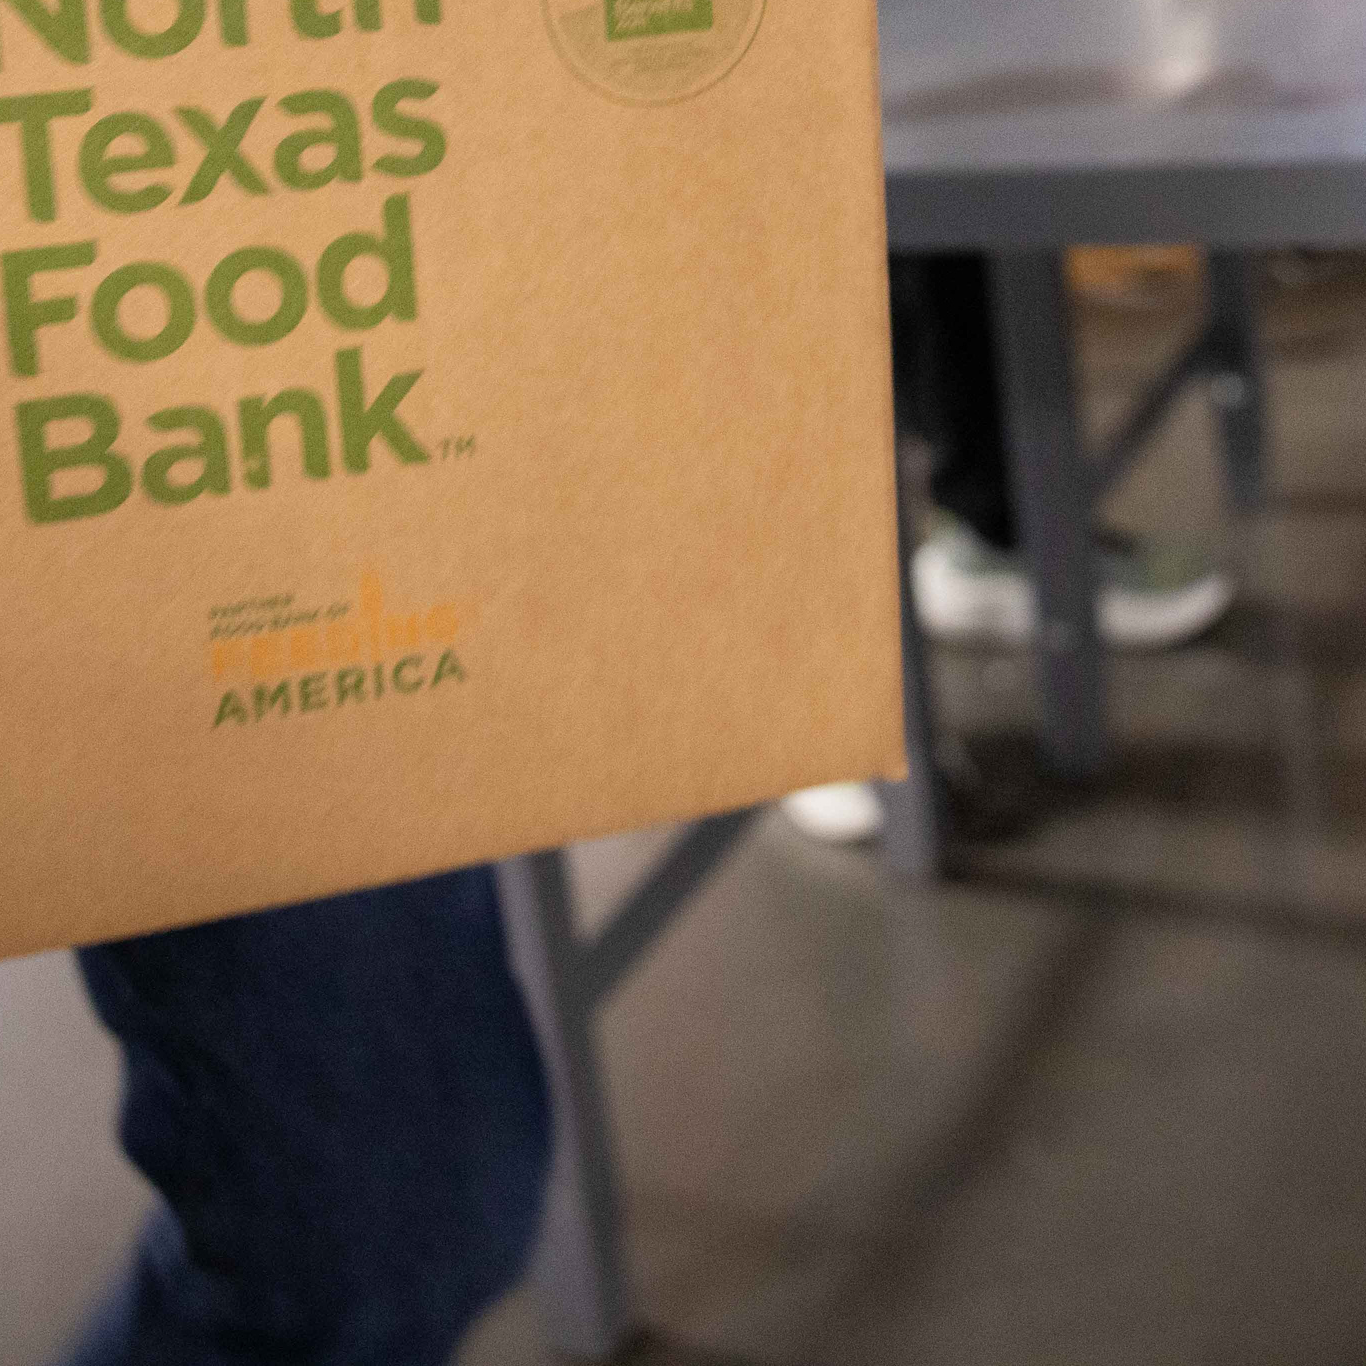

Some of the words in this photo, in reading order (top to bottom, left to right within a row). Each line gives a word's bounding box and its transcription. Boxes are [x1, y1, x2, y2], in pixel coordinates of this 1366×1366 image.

[0, 192, 417, 377] Food
[15, 346, 431, 525] Bank
[213, 648, 466, 728] AMERICA
